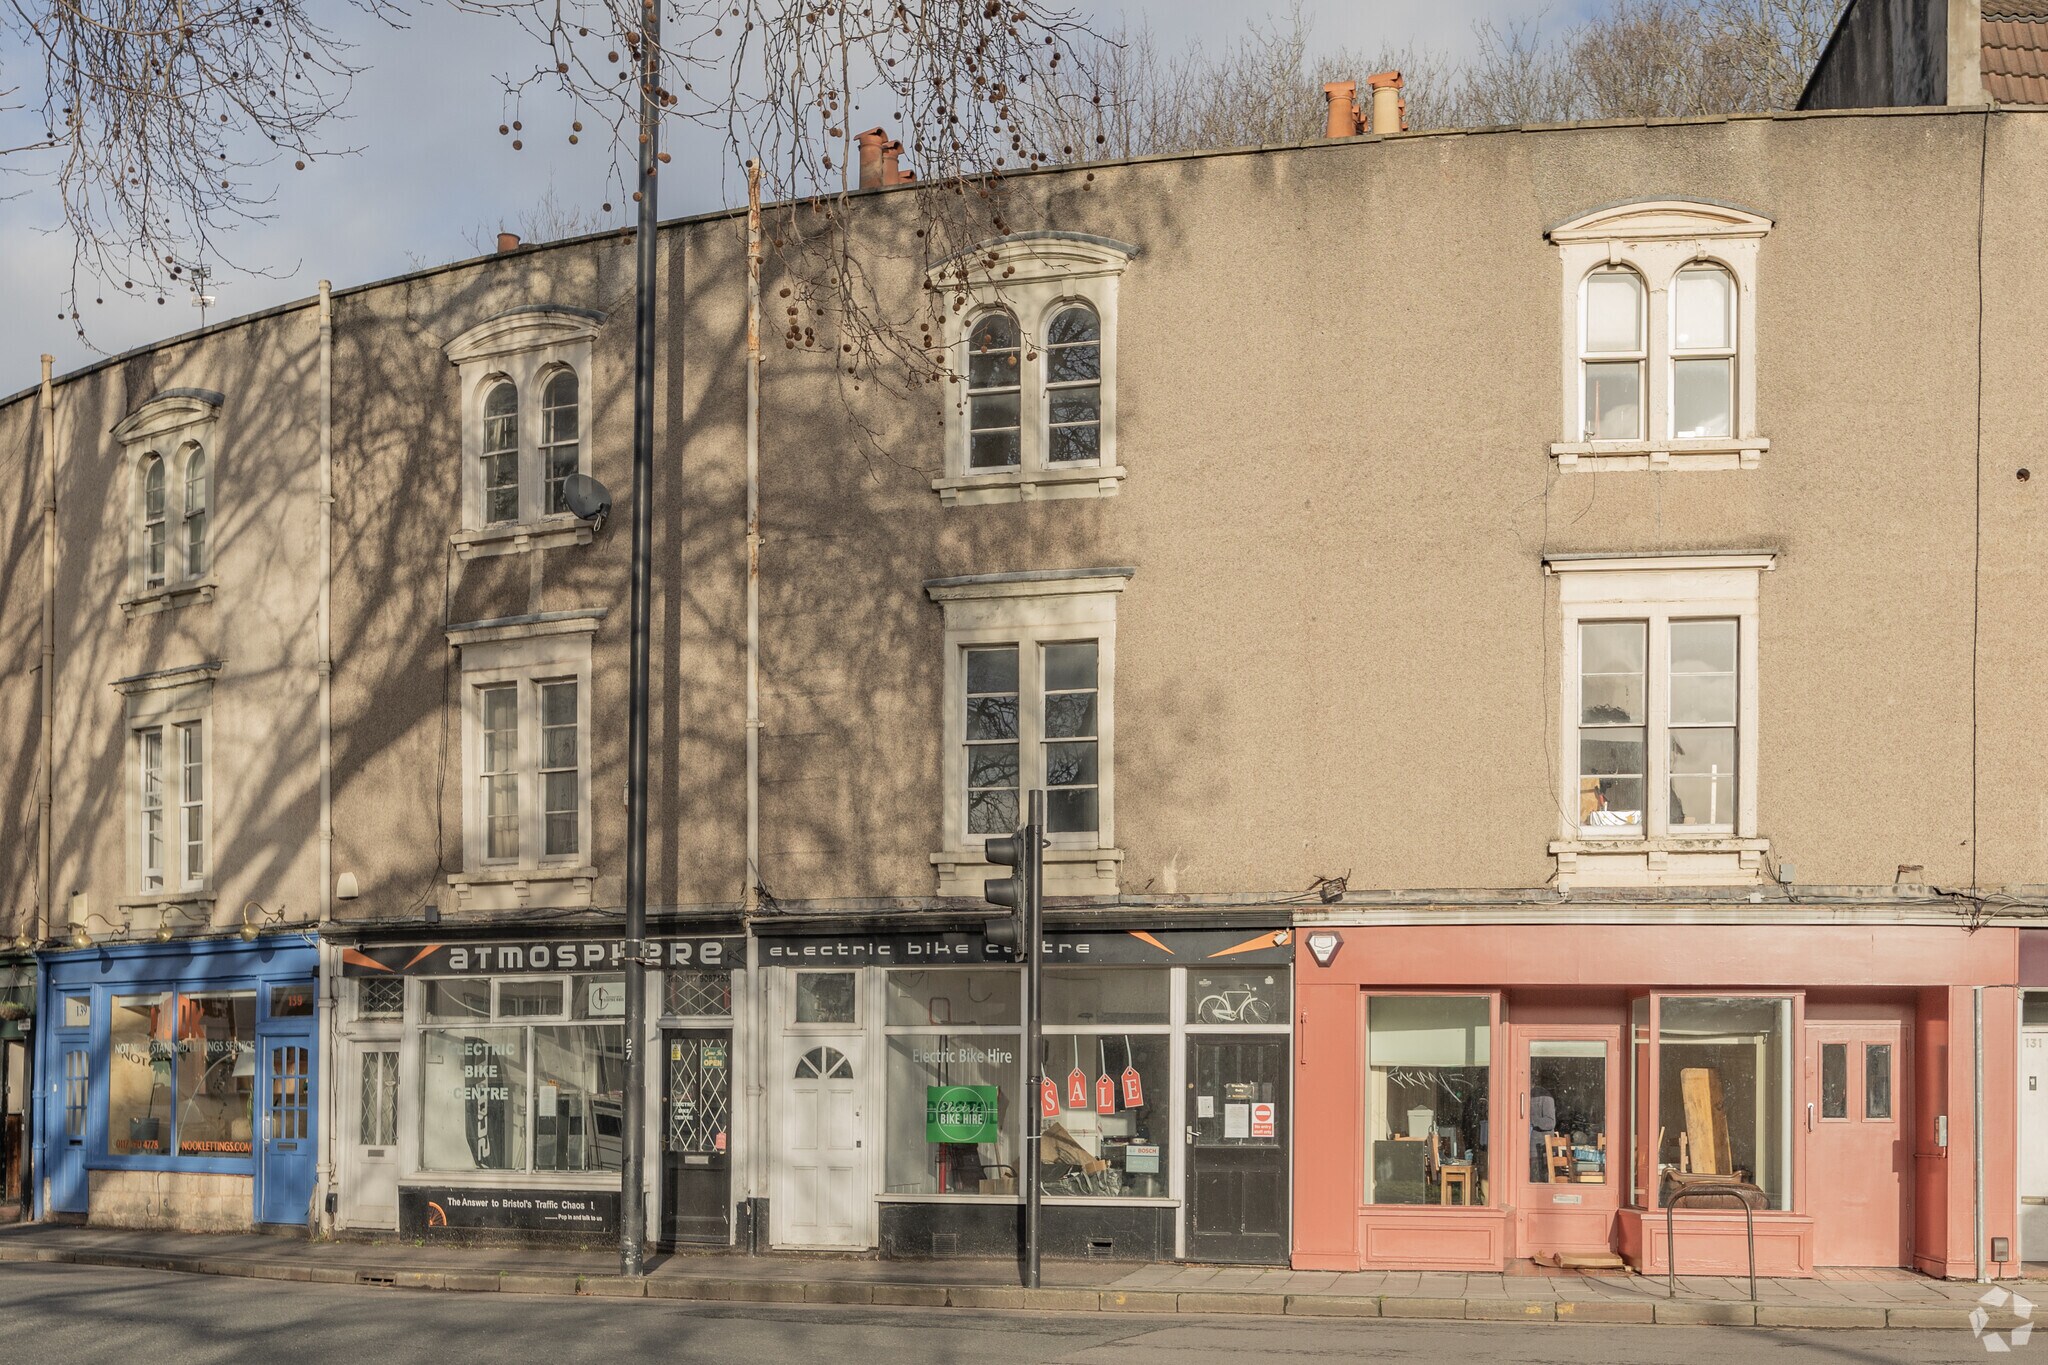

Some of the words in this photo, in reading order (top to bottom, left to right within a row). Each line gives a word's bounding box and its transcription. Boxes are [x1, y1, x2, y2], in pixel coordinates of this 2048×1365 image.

[907, 942, 969, 954] bike
[986, 941, 1090, 954] cetre
[115, 1042, 129, 1055] NOT
[2024, 1038, 2043, 1049] 131
[913, 1048, 956, 1063] Electric
[959, 1048, 985, 1063] Bike
[988, 1047, 1013, 1064] Hire
[703, 1059, 723, 1067] OPEN
[464, 1065, 498, 1078] BIKE
[453, 1086, 509, 1100] CENTRE
[940, 1101, 983, 1113] Electric
[940, 1113, 961, 1125] BIKE
[962, 1113, 983, 1125] HIRE
[143, 1139, 159, 1150] 4778
[181, 1140, 252, 1153] NOOKLETTINGS.COM
[447, 1197, 461, 1206] The
[461, 1197, 489, 1208] Answer
[491, 1199, 500, 1208] to
[502, 1199, 533, 1209] Bristol's
[535, 1200, 559, 1210] Traffic
[561, 1201, 586, 1210] Chaos
